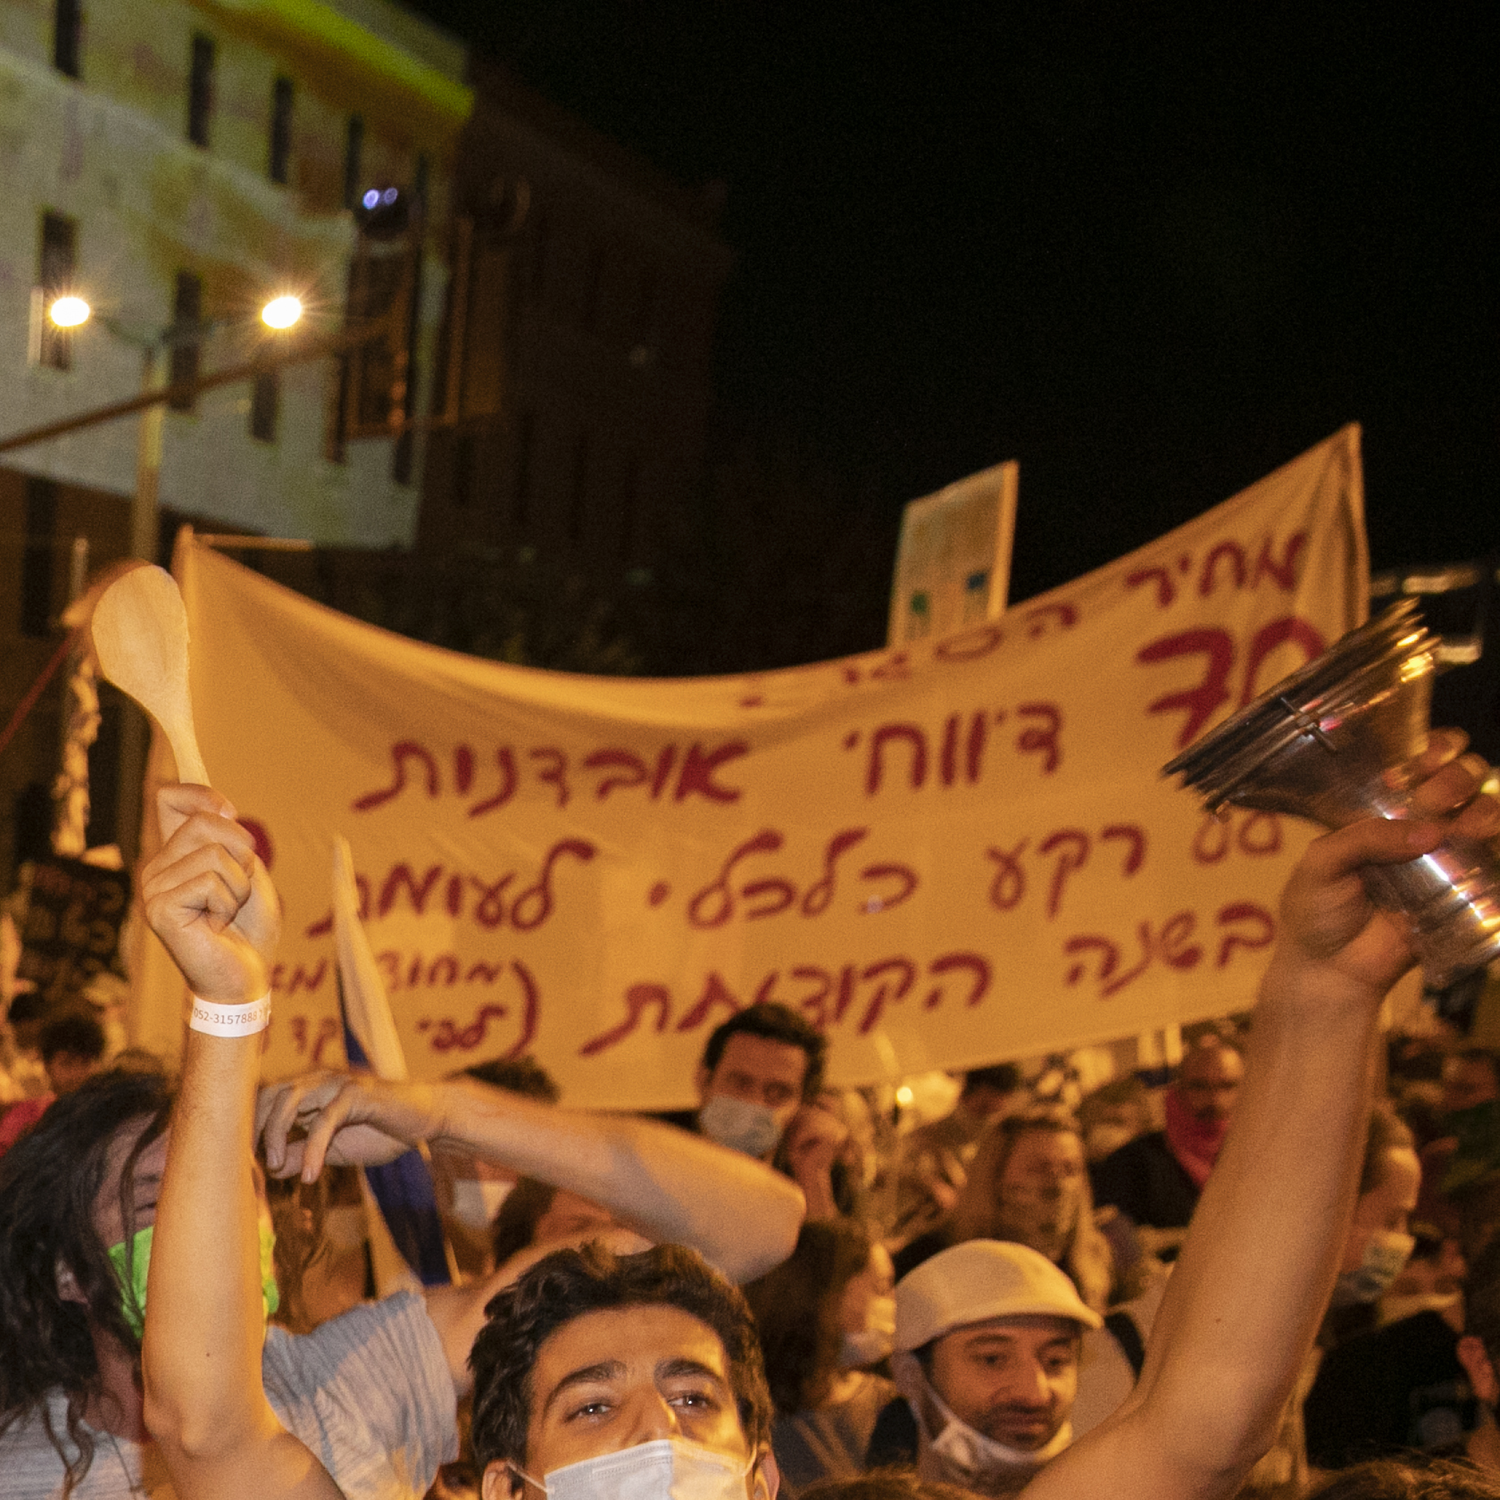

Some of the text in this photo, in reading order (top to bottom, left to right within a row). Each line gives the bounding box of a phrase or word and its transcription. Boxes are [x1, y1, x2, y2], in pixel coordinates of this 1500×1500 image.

[1124, 532, 1308, 606] מחיר
[352, 738, 752, 820] אובדנות
[843, 703, 1062, 795] דיווחי
[644, 825, 919, 930] כלכלי
[987, 824, 1147, 924] רקע
[1063, 902, 1276, 998] בשנה
